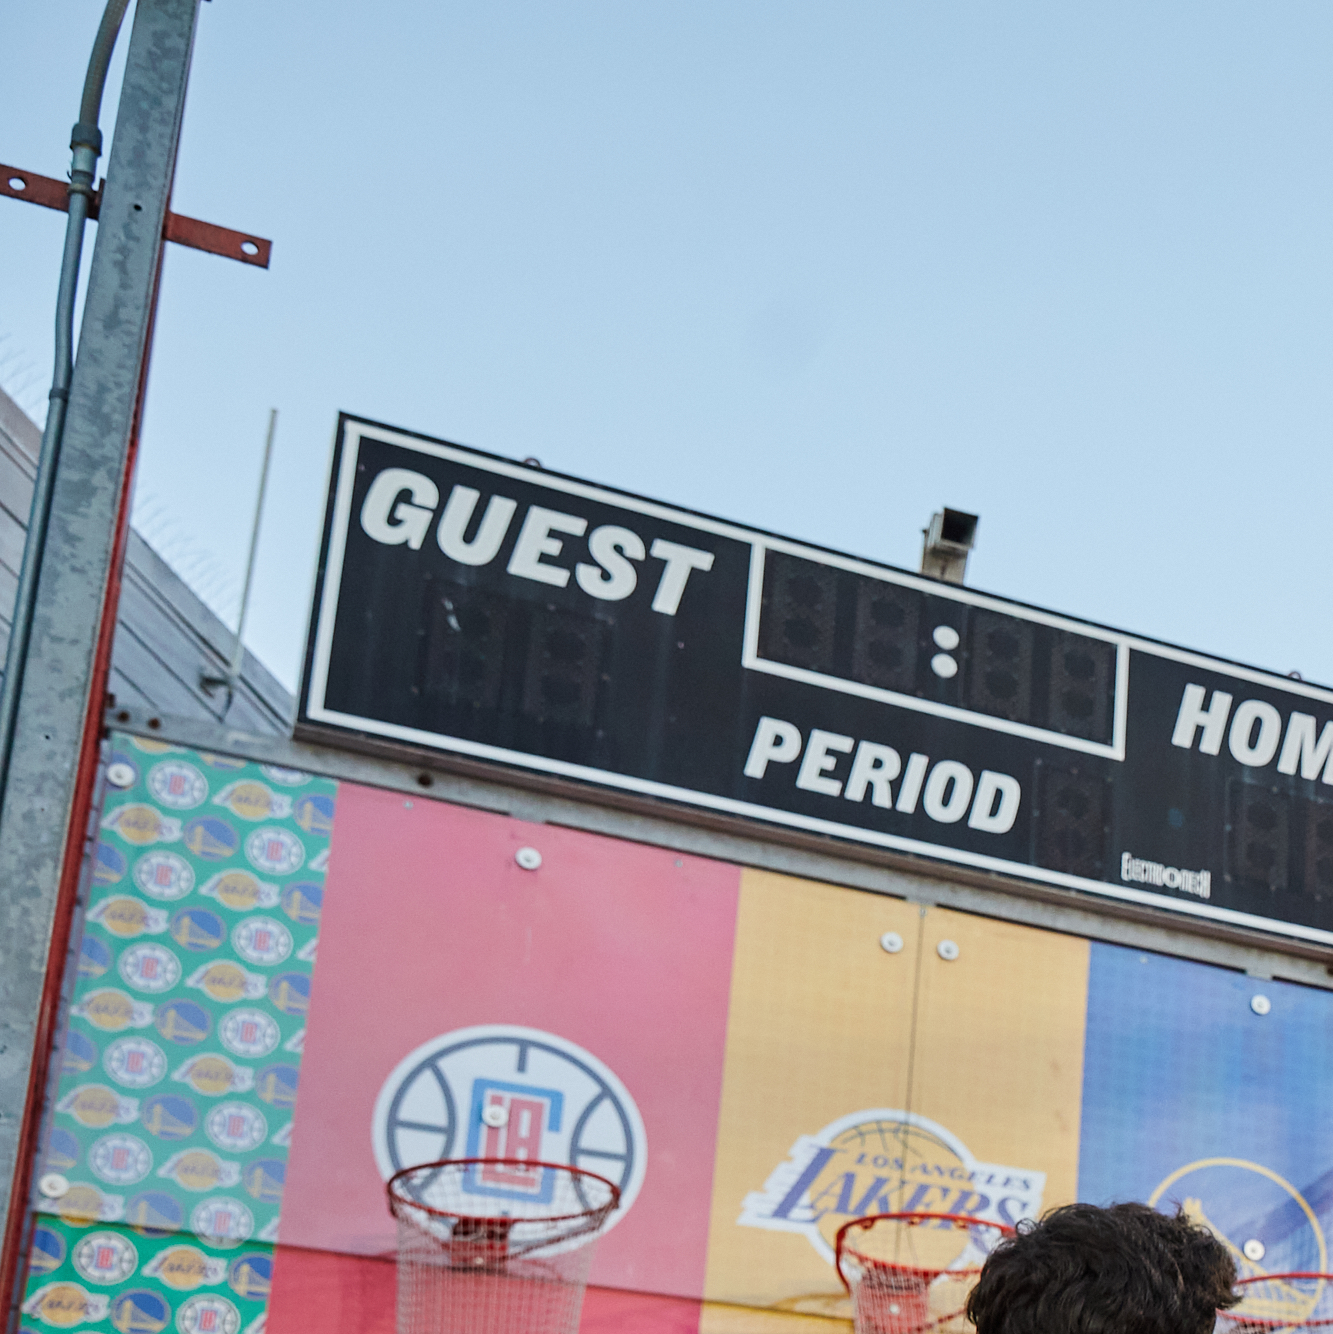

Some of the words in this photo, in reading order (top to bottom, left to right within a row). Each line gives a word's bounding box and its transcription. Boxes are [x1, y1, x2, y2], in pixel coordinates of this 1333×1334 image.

[360, 467, 714, 614] GUEST
[743, 716, 1022, 834] PERIOD
[852, 1152, 904, 1170] LOS
[910, 1162, 1032, 1191] ANGELES
